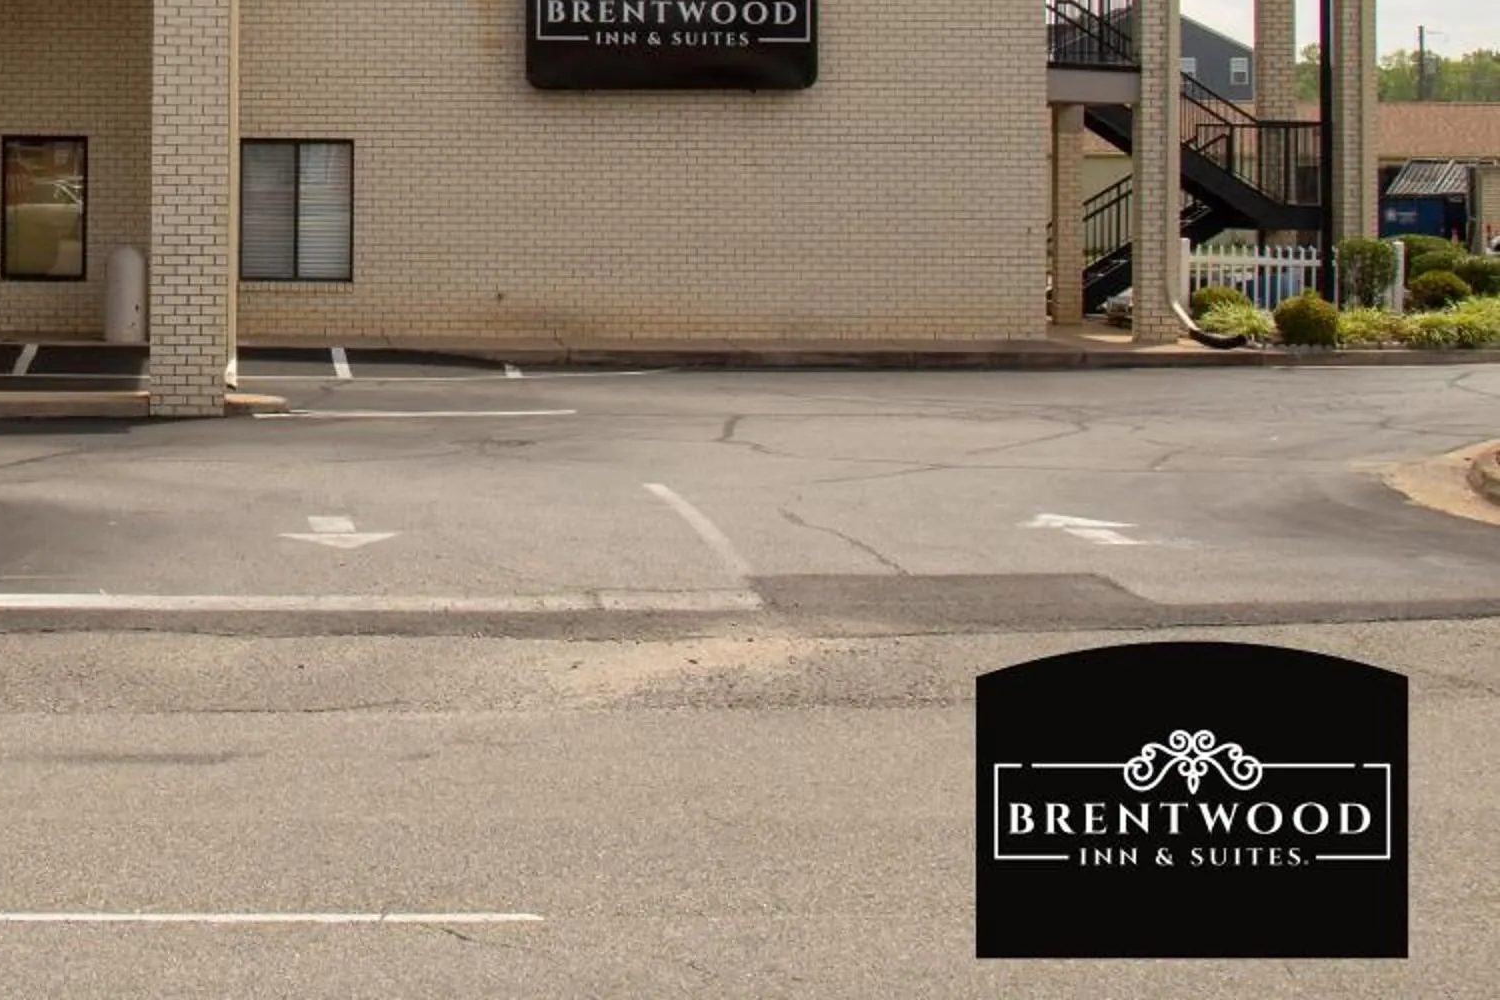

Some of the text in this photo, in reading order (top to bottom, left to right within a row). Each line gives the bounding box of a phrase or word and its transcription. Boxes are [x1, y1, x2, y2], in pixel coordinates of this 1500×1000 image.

[547, 0, 797, 26] BRENTWOOD
[595, 31, 750, 47] INN & SUITES
